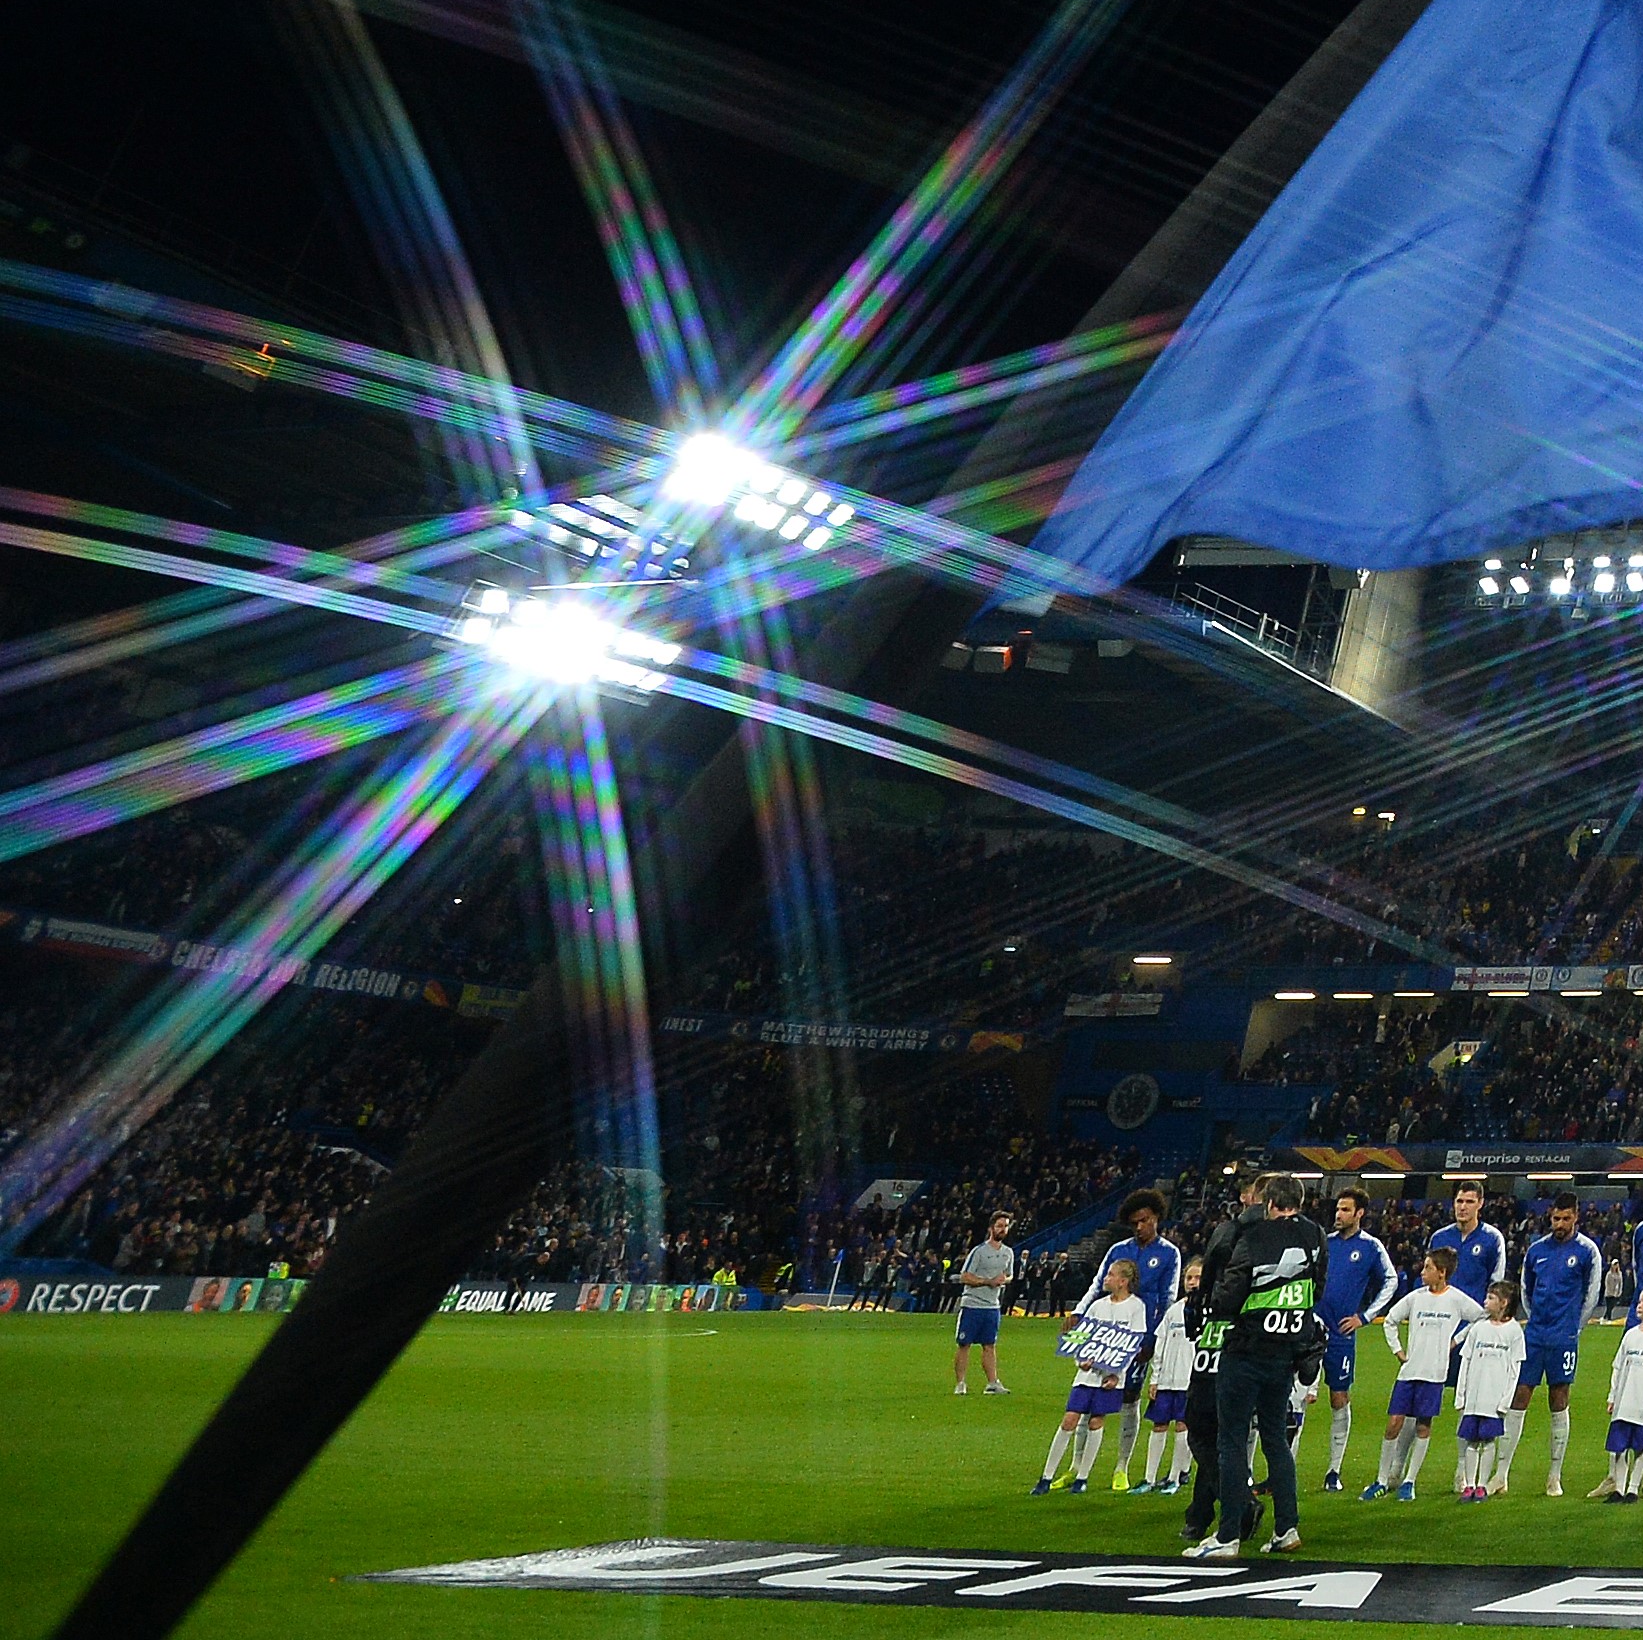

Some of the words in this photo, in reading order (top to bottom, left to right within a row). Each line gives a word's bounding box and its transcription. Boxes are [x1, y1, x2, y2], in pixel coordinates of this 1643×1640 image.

[313, 962, 400, 998] RELIGION
[760, 1020, 843, 1038] MATTHEW
[825, 1036, 876, 1049] WHITE
[26, 1282, 161, 1312] RESPECT
[1263, 1310, 1304, 1334] 013
[1080, 1344, 1128, 1368] GAME
[1341, 1355, 1351, 1374] 4
[1562, 1351, 1576, 1371] 33
[538, 1546, 1384, 1610] UEFA
